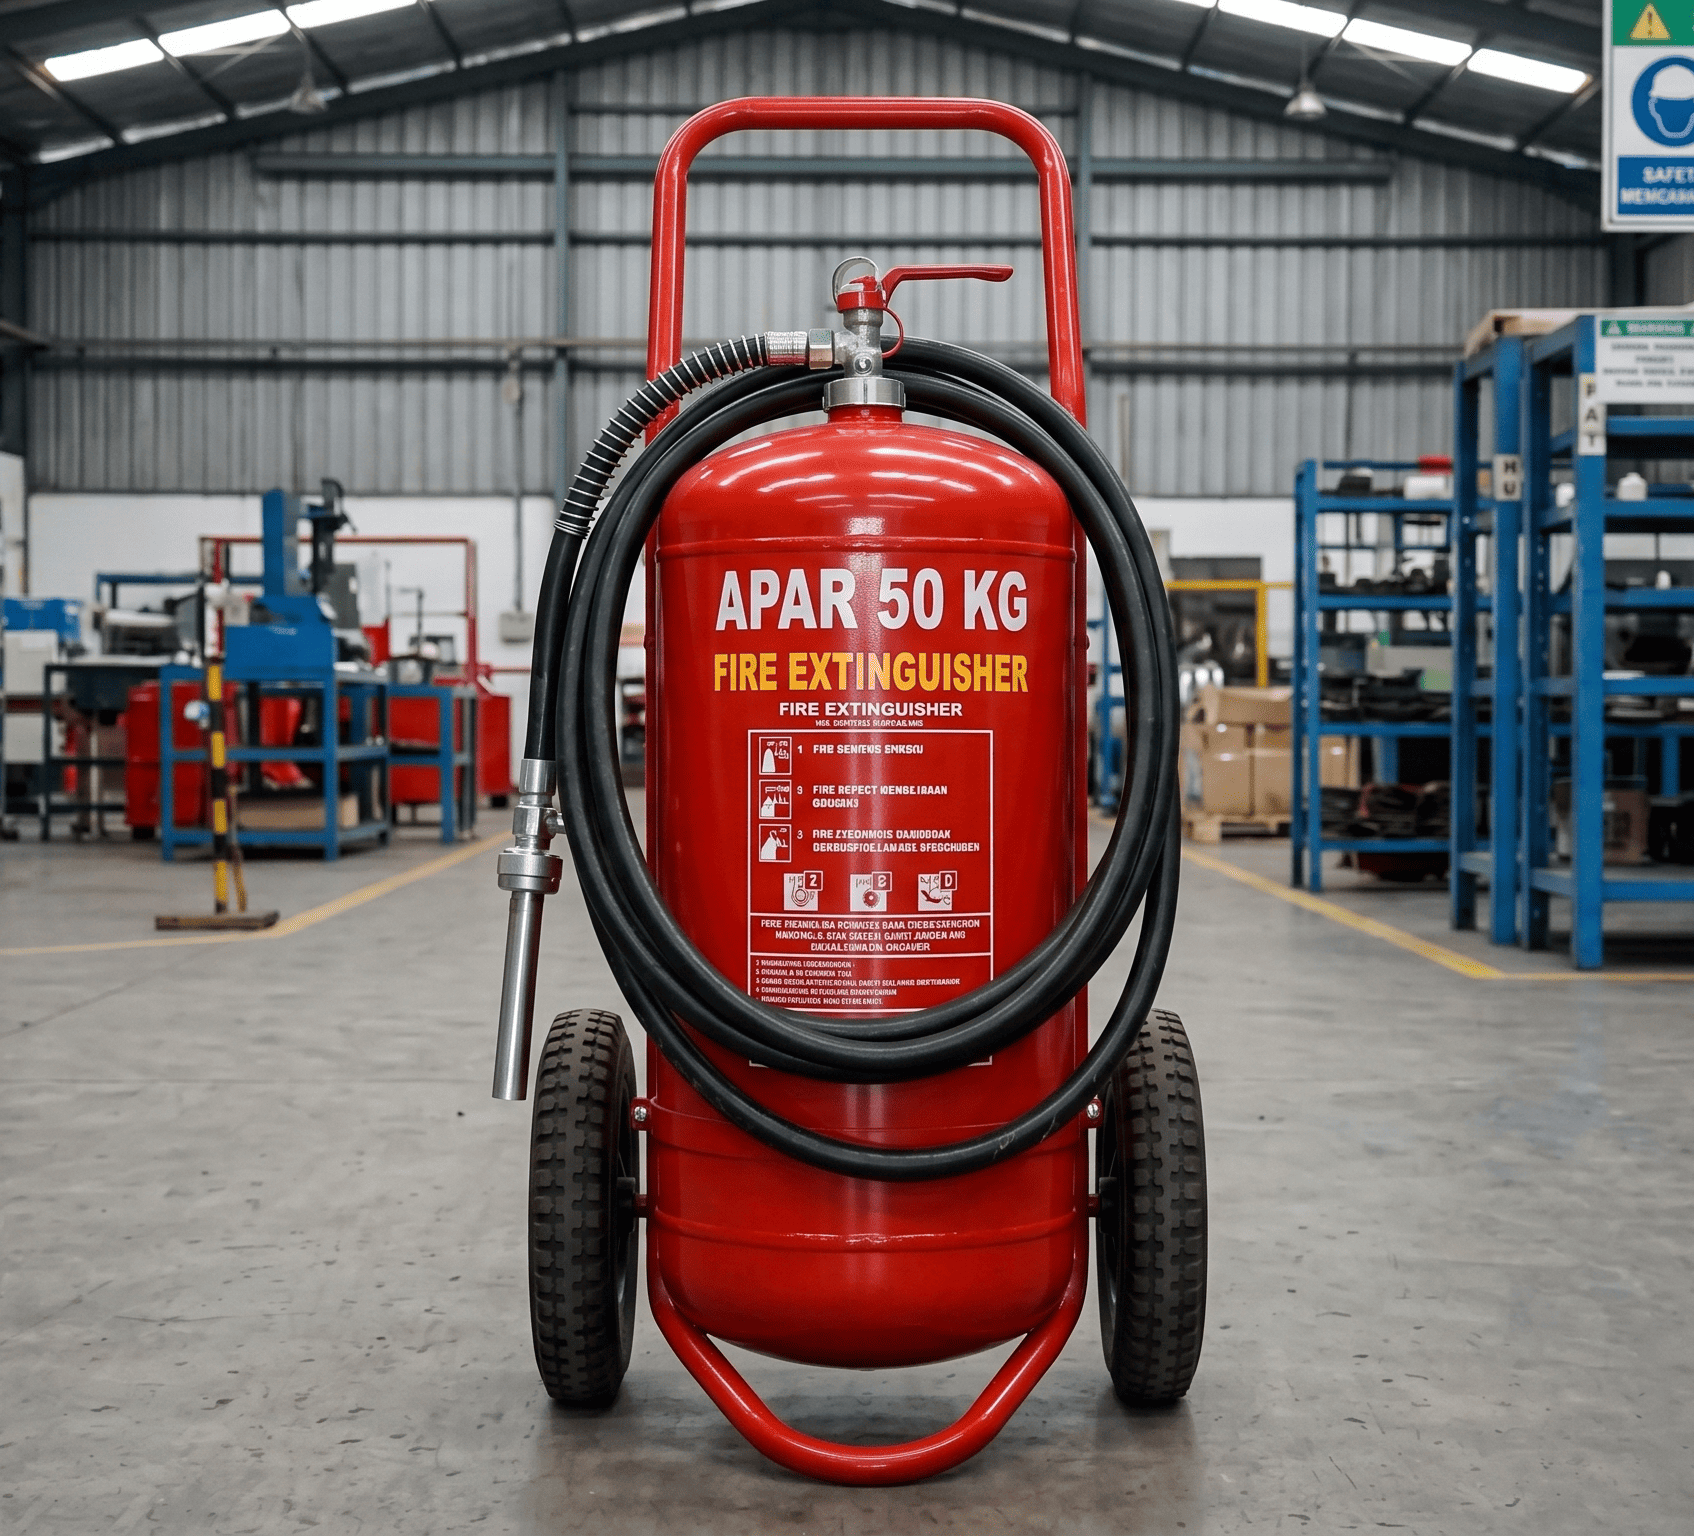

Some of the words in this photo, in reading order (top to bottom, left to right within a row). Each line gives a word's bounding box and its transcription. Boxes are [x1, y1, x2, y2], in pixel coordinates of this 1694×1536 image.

[715, 568, 859, 631] APAR
[877, 567, 944, 630] 50
[963, 569, 1028, 632] KG
[714, 653, 777, 692] FIRE
[788, 652, 1029, 693] EXTINGUISHER
[779, 702, 819, 716] FIRE
[825, 702, 963, 717] EXTINGUISHER
[797, 744, 803, 754] 1
[812, 785, 835, 795] FIRE
[809, 874, 818, 887] 2
[944, 874, 953, 887] D
